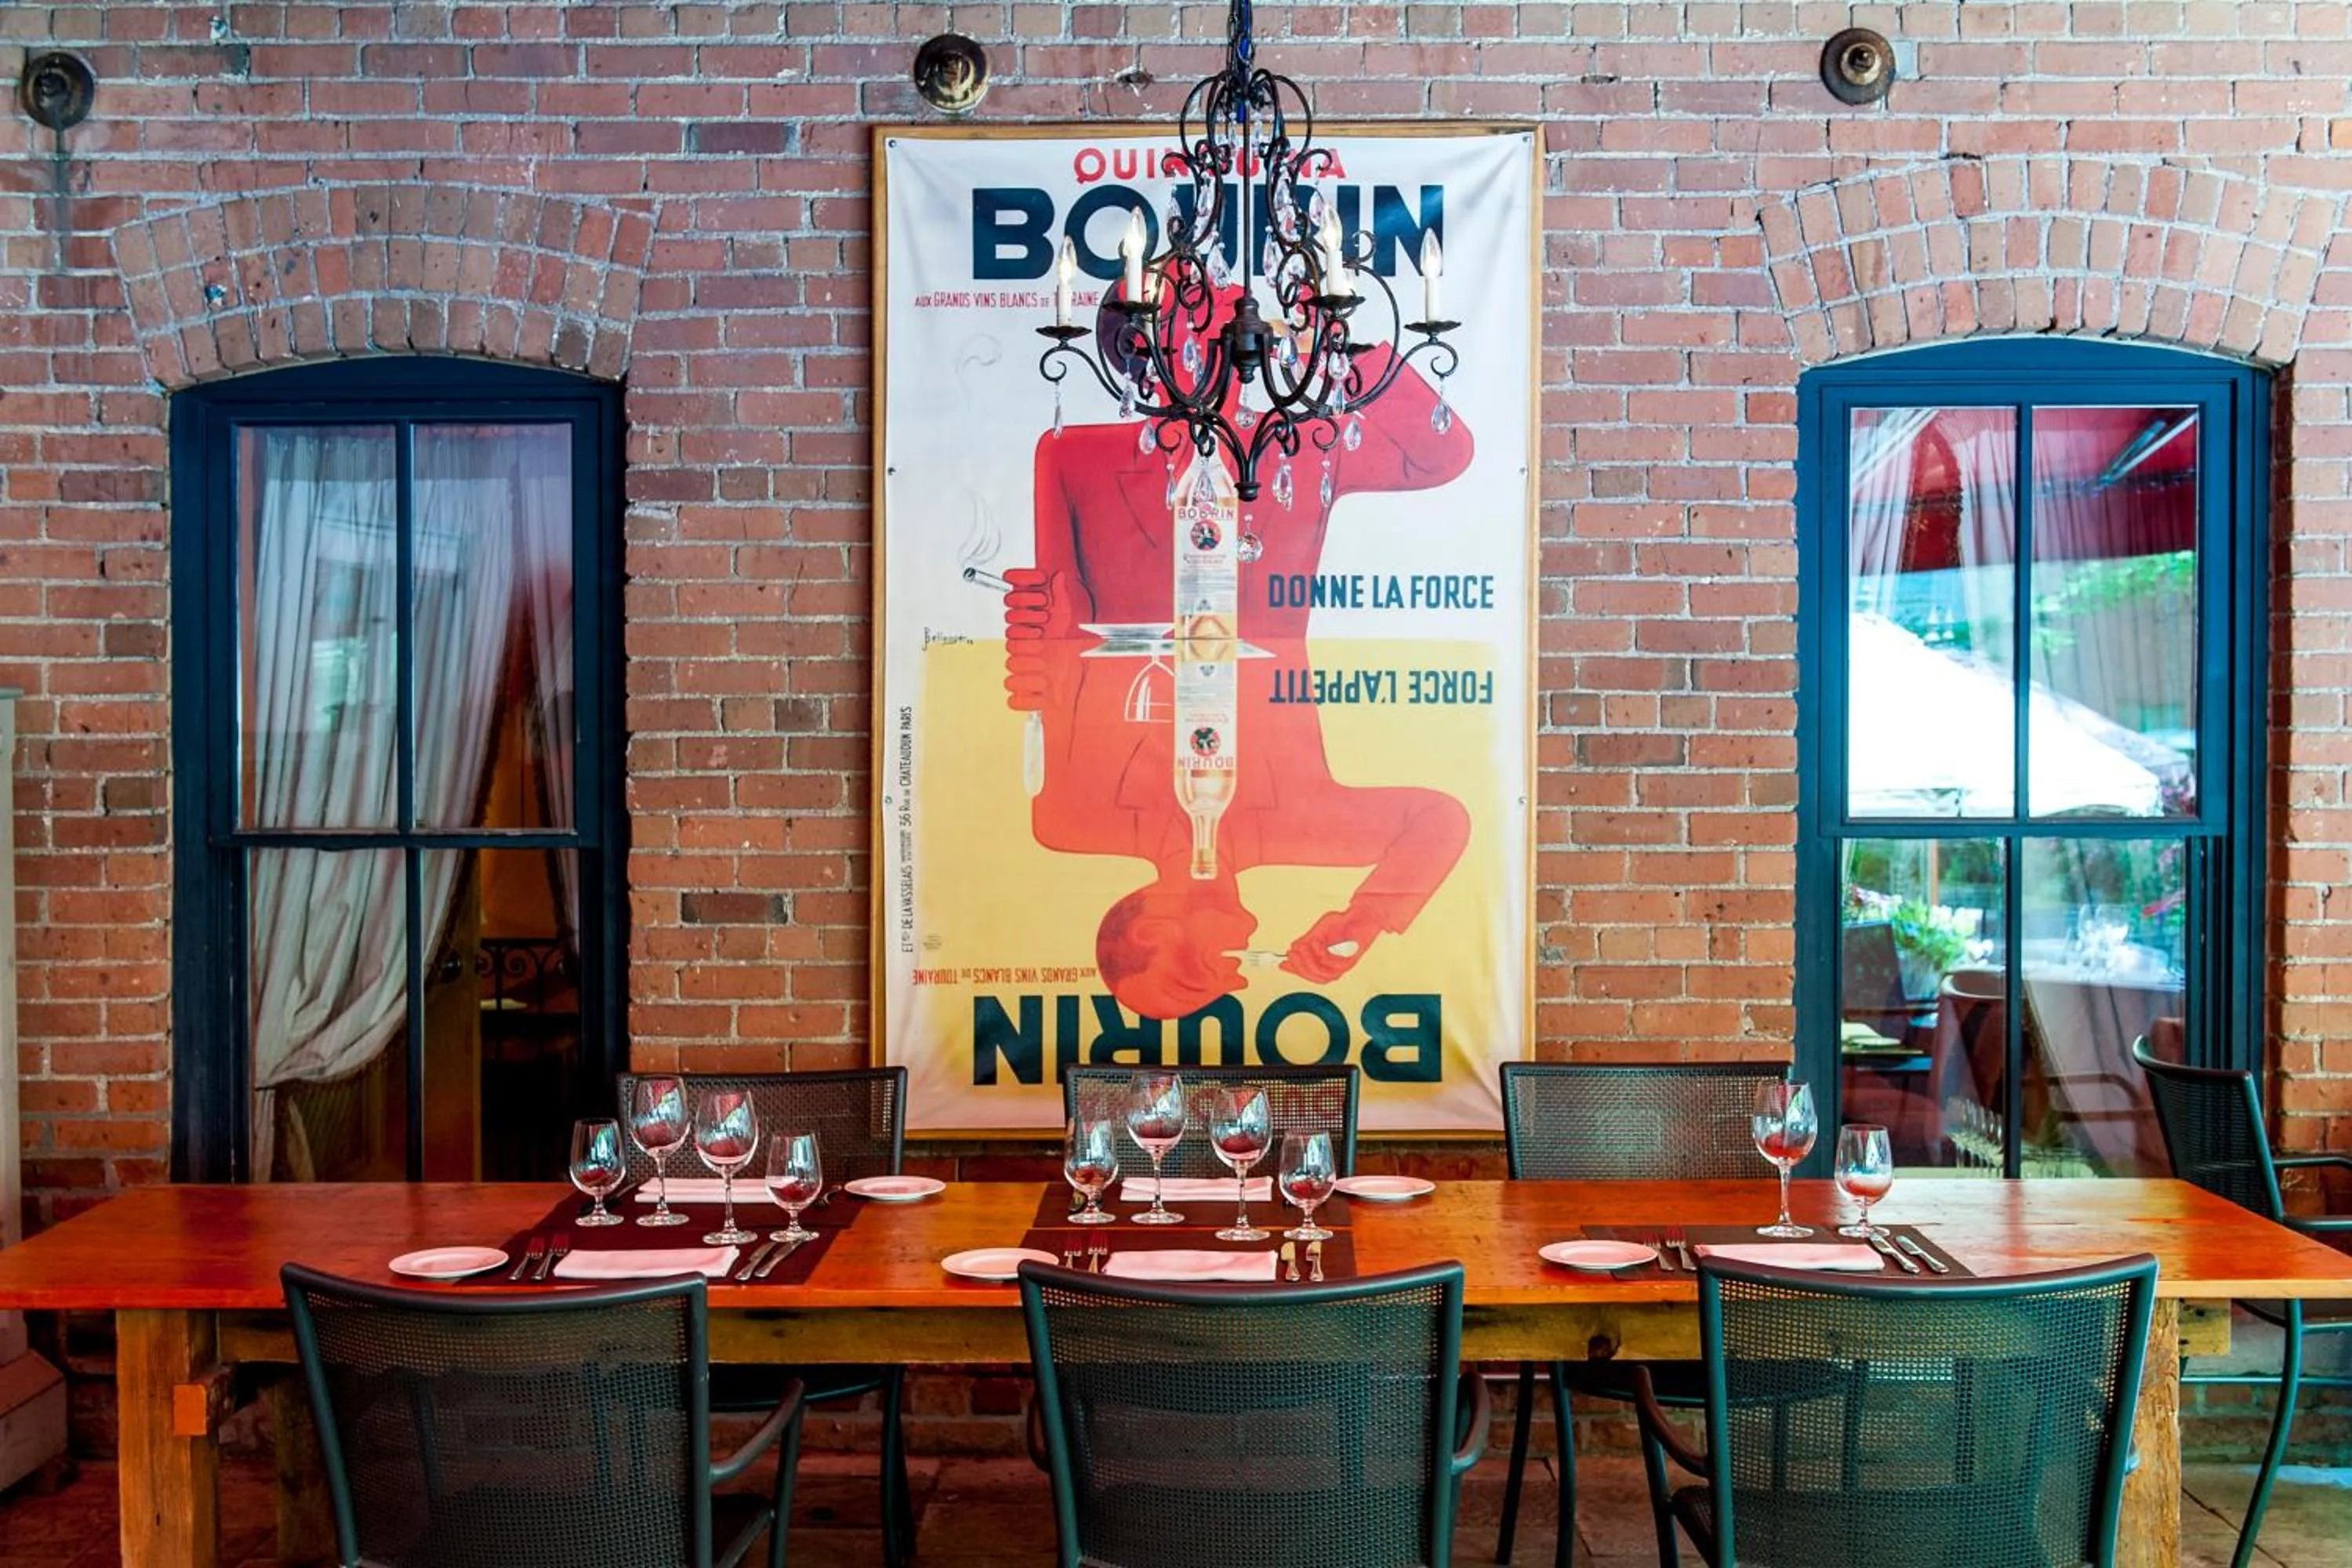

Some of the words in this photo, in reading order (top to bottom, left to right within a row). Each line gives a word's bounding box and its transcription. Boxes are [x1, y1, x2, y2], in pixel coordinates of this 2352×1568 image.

[972, 184, 1445, 281] BOURIN
[915, 296, 931, 307] AUX
[933, 292, 971, 308] GRANDS
[973, 292, 997, 308] VINS
[1000, 292, 1038, 308] BLANCS
[1054, 291, 1099, 307] TRAINE
[1269, 575, 1364, 608] DONNE
[1372, 575, 1405, 608] LA
[1410, 575, 1494, 608] FORCE
[1409, 670, 1493, 704] FORCE
[900, 706, 912, 730] PARIS
[899, 813, 912, 826] 36
[913, 968, 957, 985] TOURAINE
[973, 967, 1012, 984] BLANCS
[1015, 967, 1039, 984] VINS
[1041, 967, 1078, 983] GRANDS
[1080, 967, 1096, 978] AUX
[972, 992, 1443, 1087] BOURIN
